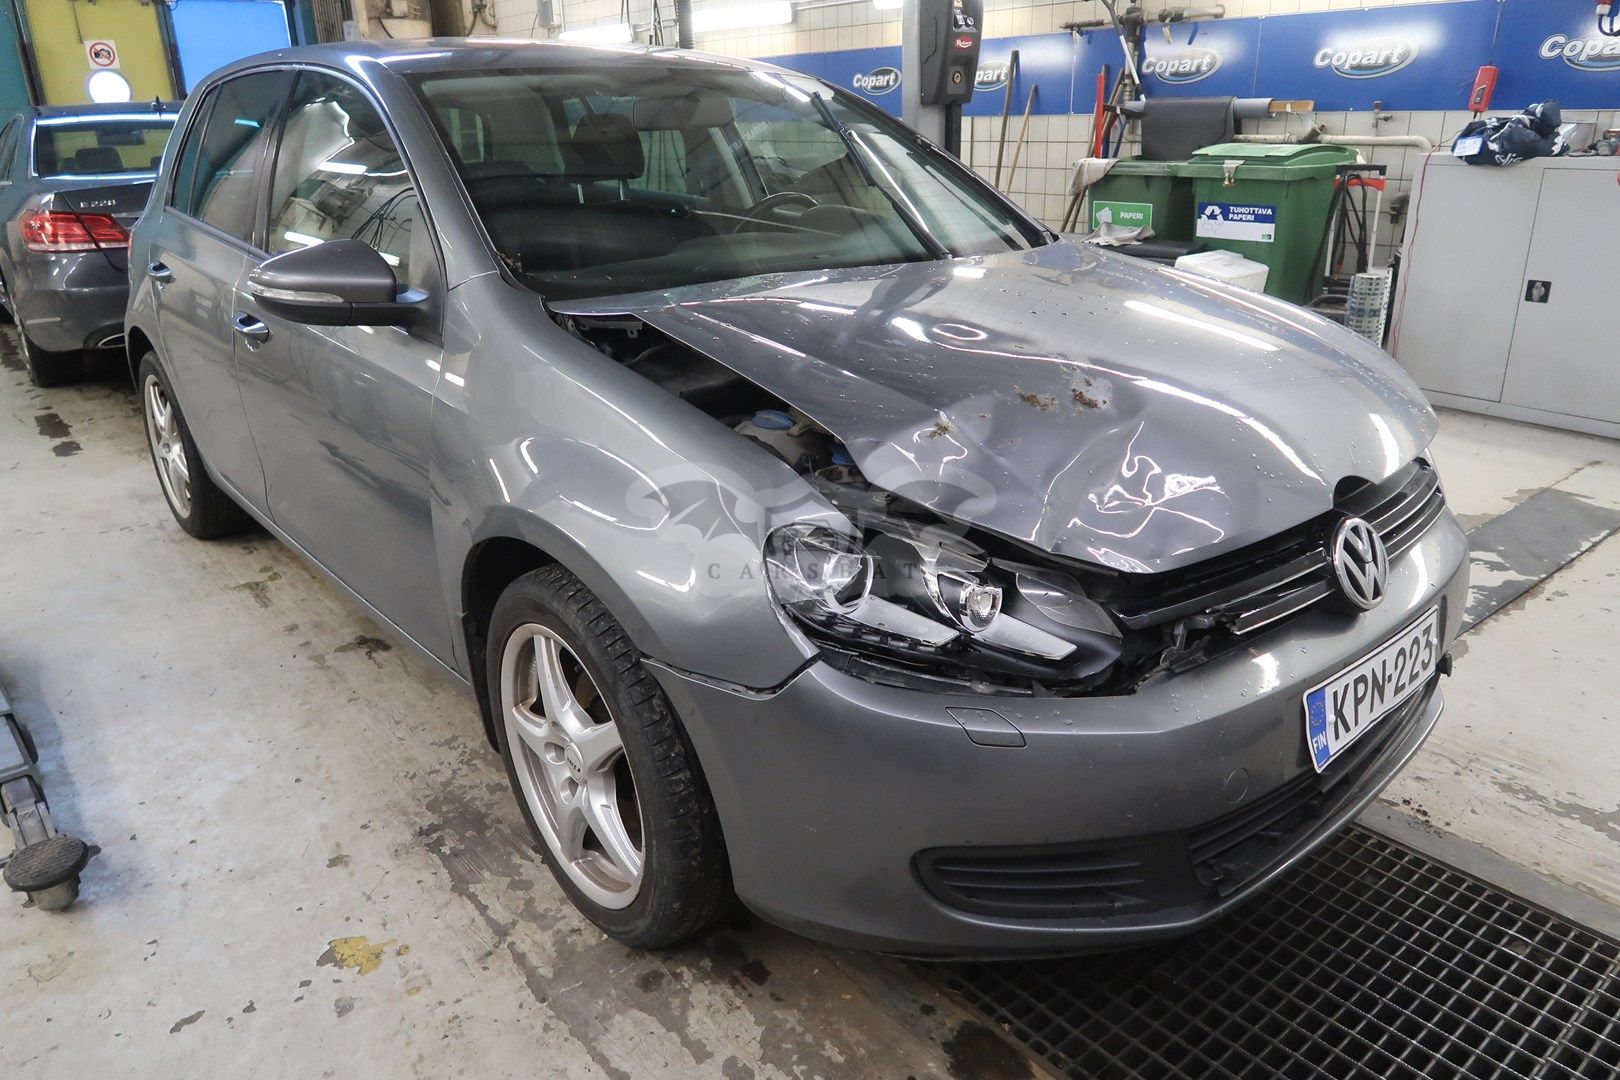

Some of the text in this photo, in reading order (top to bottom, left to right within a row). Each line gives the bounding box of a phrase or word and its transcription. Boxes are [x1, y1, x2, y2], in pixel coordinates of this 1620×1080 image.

[1312, 46, 1404, 70] Copart
[1538, 33, 1620, 63] Copa
[974, 66, 1008, 85] part
[1141, 55, 1211, 77] Copart
[853, 72, 896, 90] Copart
[1120, 211, 1144, 220] PAPERI
[1228, 213, 1255, 221] PAPERI
[1229, 206, 1273, 215] TUHOTTAVA
[1332, 622, 1434, 741] KPN-223
[1312, 730, 1328, 755] FIN
